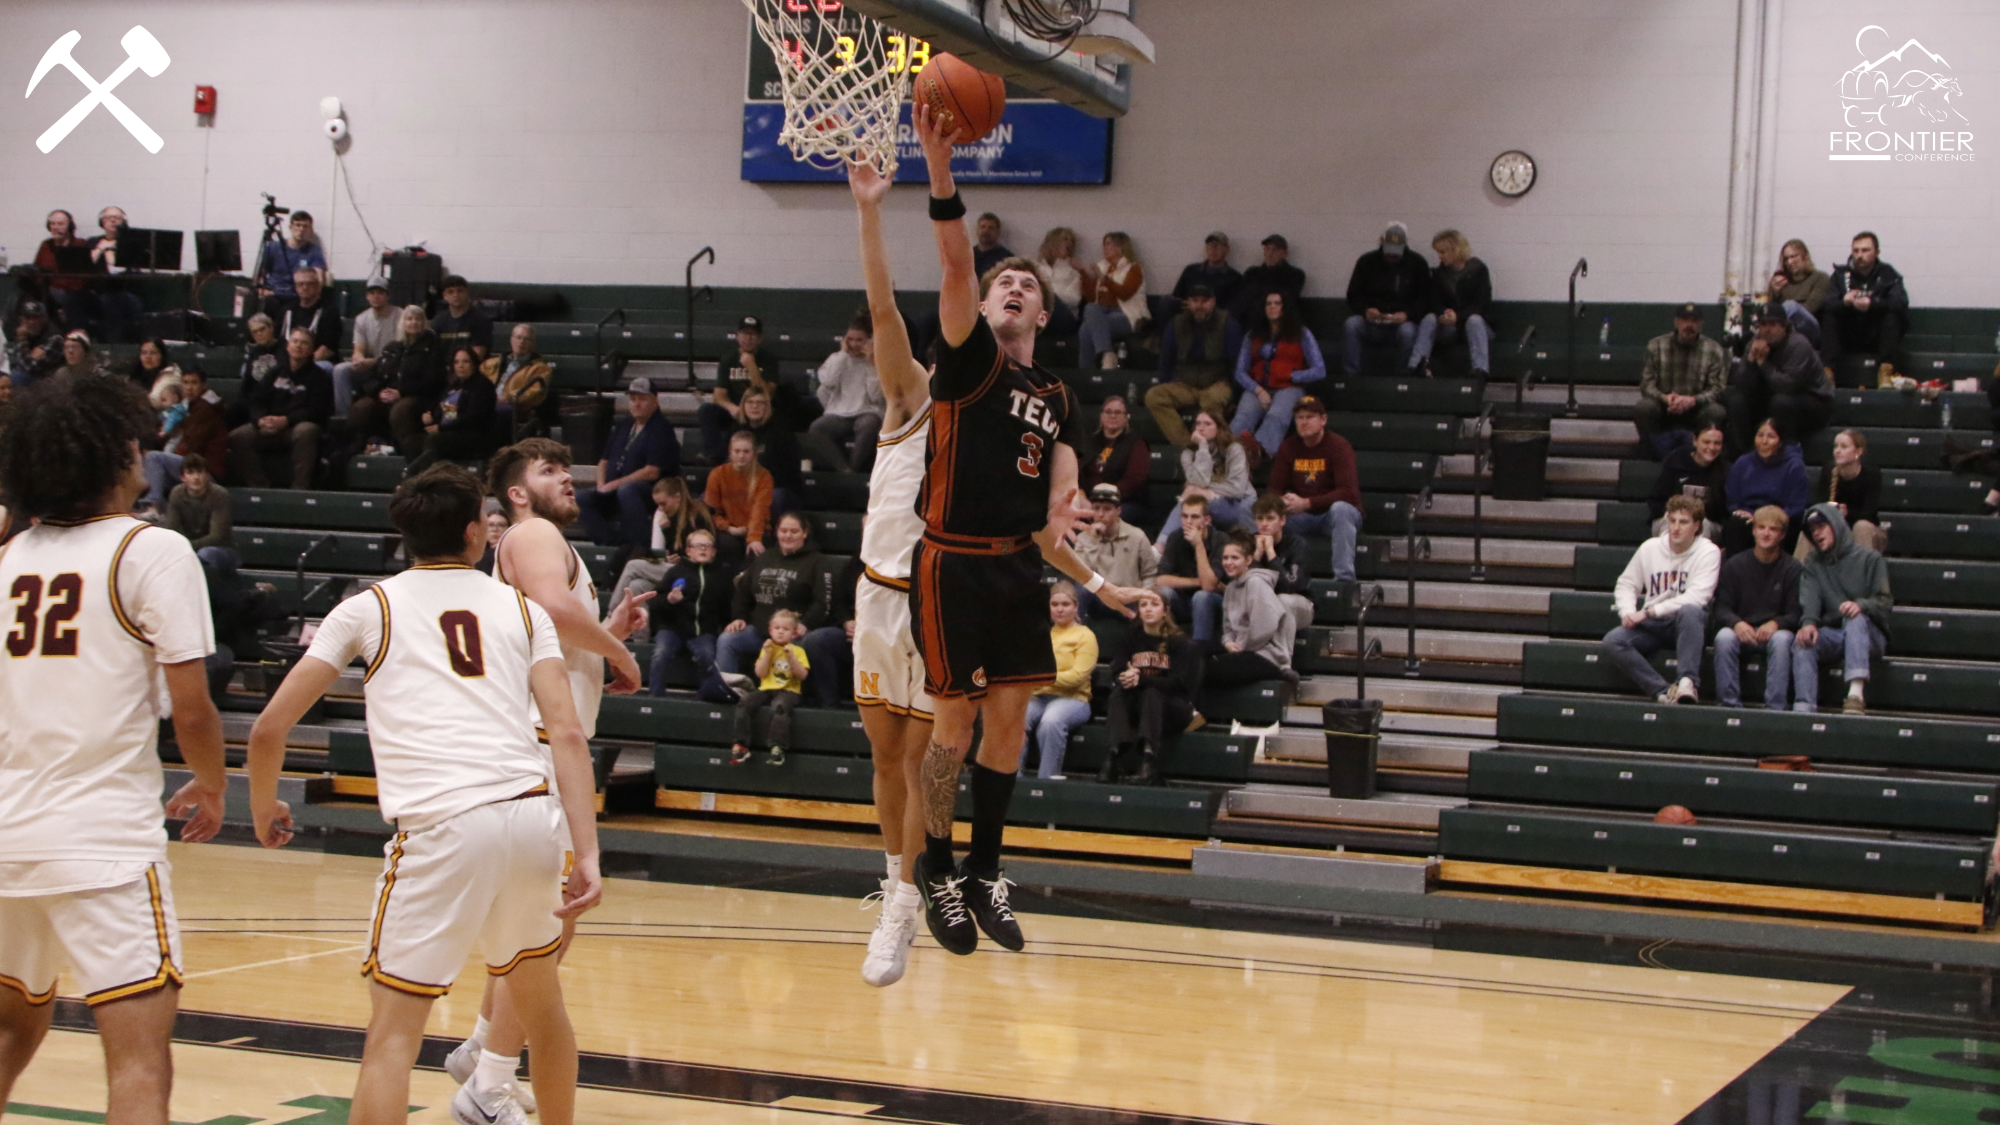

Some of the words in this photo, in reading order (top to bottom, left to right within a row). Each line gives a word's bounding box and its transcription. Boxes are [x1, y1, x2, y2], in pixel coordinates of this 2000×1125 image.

[835, 36, 855, 73] 3
[886, 36, 930, 73] 33
[1009, 389, 1060, 440] TEC
[1017, 431, 1044, 477] 3
[6, 571, 83, 659] 32
[438, 608, 486, 679] 0
[860, 670, 880, 696] N
